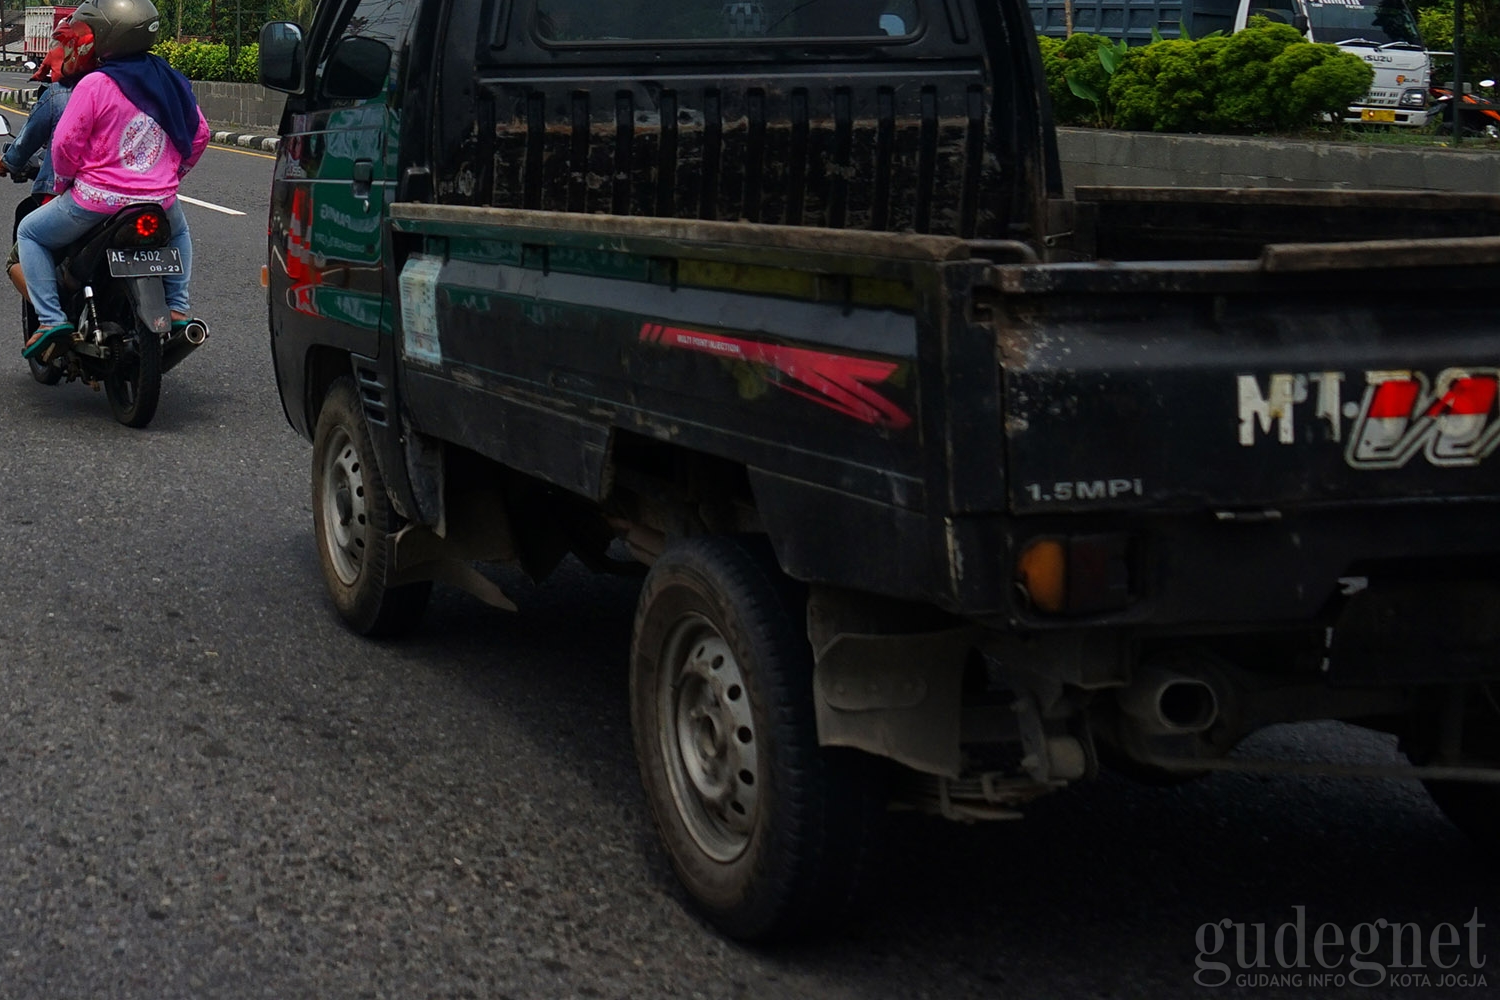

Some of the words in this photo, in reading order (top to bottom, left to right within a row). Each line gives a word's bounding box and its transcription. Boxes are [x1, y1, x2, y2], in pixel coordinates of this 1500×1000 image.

[111, 251, 126, 263] AE
[133, 250, 161, 262] 4502
[170, 250, 177, 260] Y
